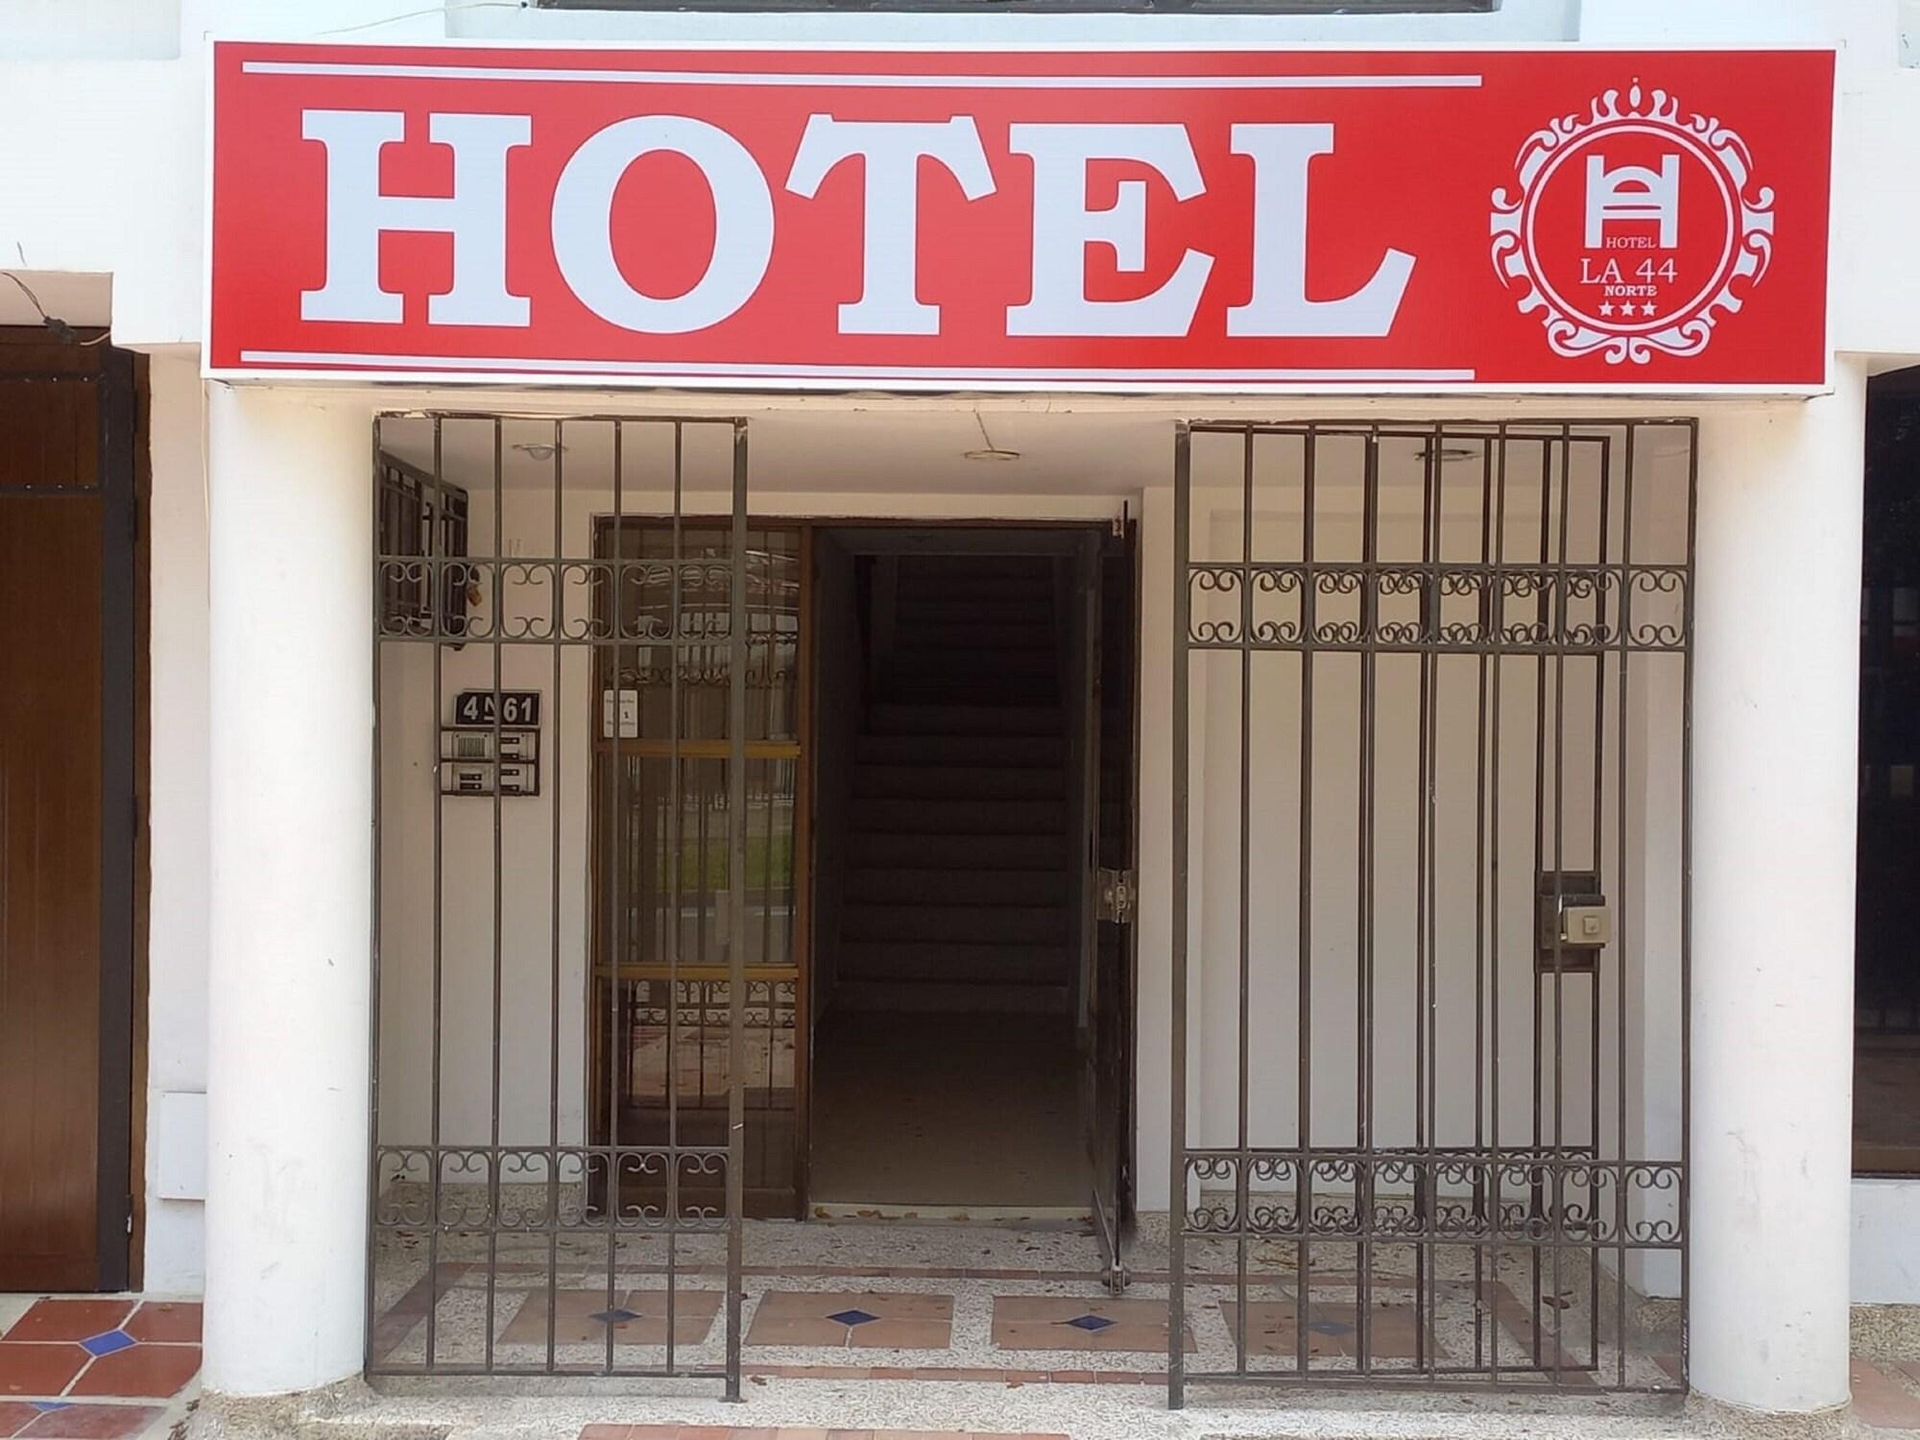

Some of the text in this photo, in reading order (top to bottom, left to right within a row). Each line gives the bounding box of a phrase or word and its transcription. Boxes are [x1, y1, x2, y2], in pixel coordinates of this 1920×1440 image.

[300, 109, 1417, 338] HOTEL
[1606, 236, 1656, 249] HOTEL
[1580, 257, 1678, 284] LA 44
[1604, 284, 1658, 297] NORTE
